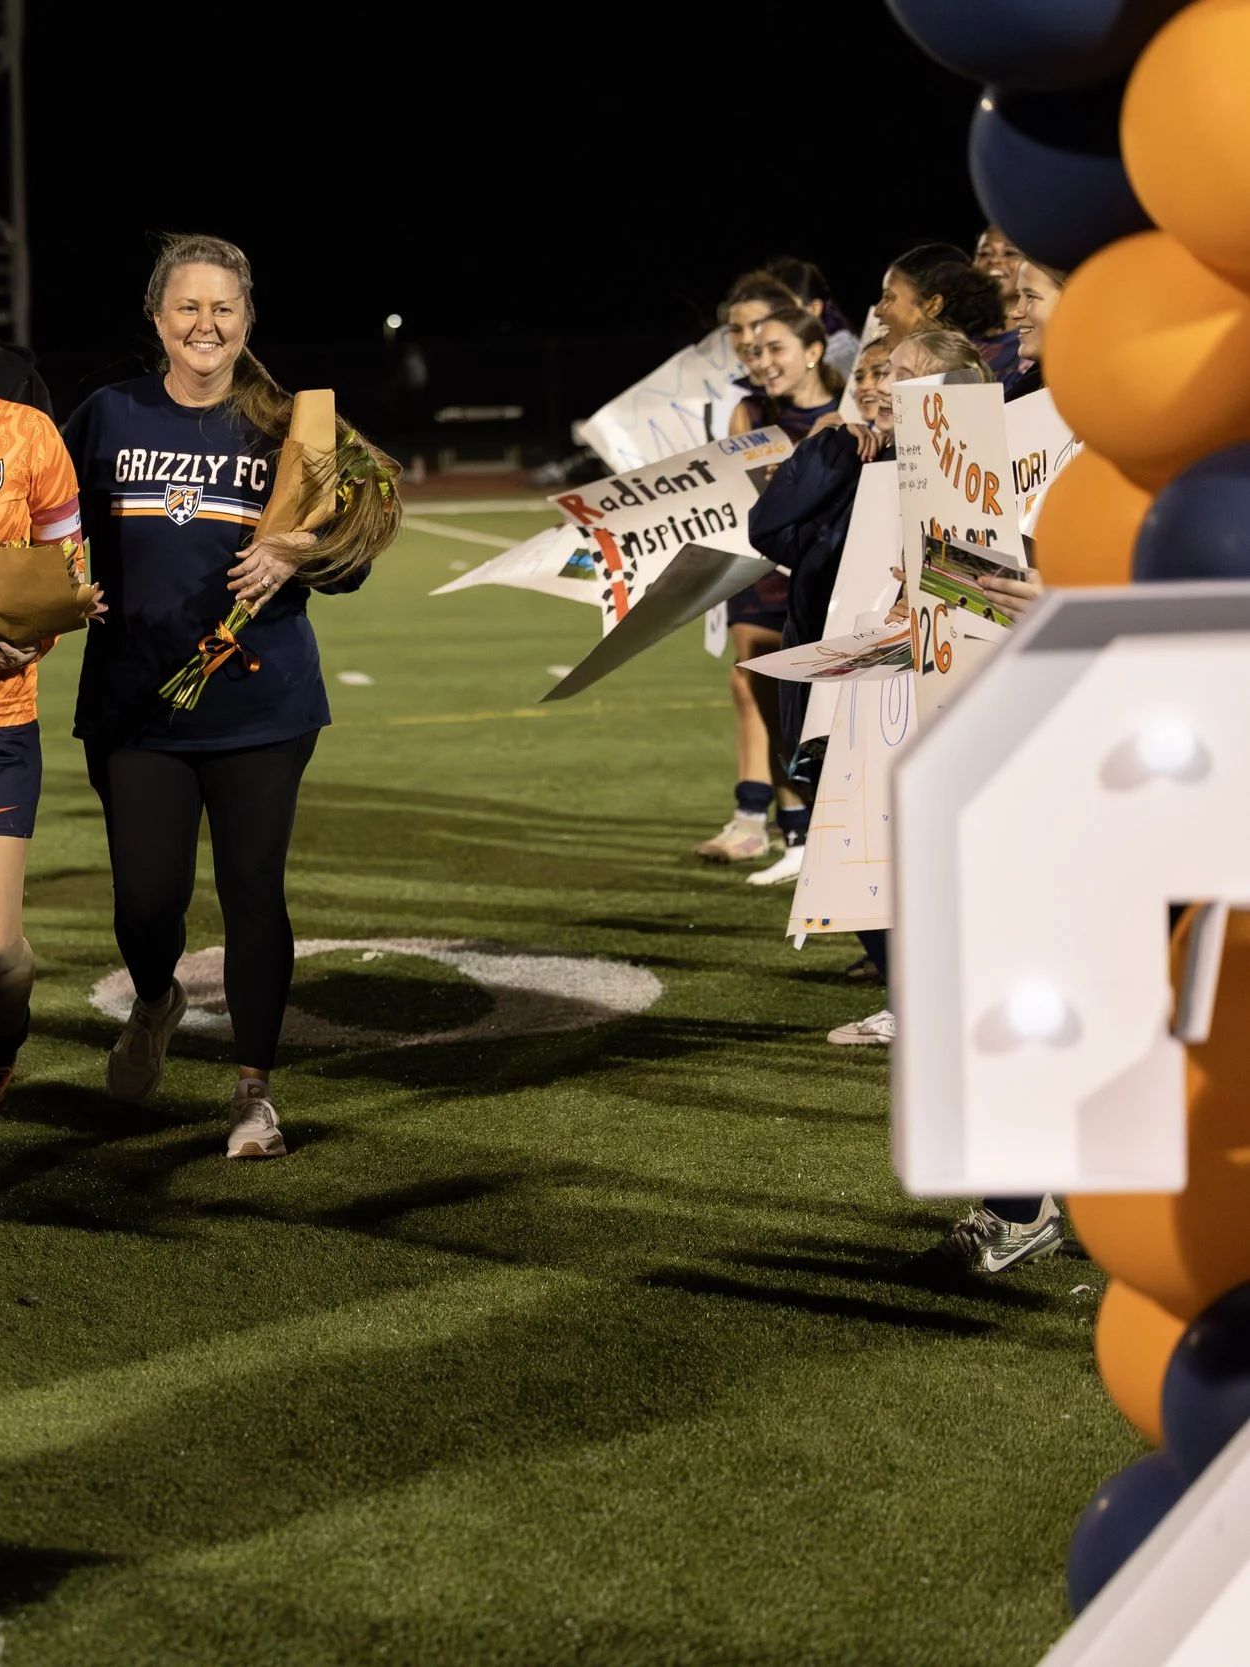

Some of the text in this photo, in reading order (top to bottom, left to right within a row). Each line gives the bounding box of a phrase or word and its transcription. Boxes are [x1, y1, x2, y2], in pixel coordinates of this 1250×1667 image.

[115, 448, 268, 492] GRIZZLY FC
[923, 392, 1003, 516] SENIOR
[556, 459, 717, 526] Radiant
[592, 502, 738, 573] Inspiring
[966, 528, 998, 547] our
